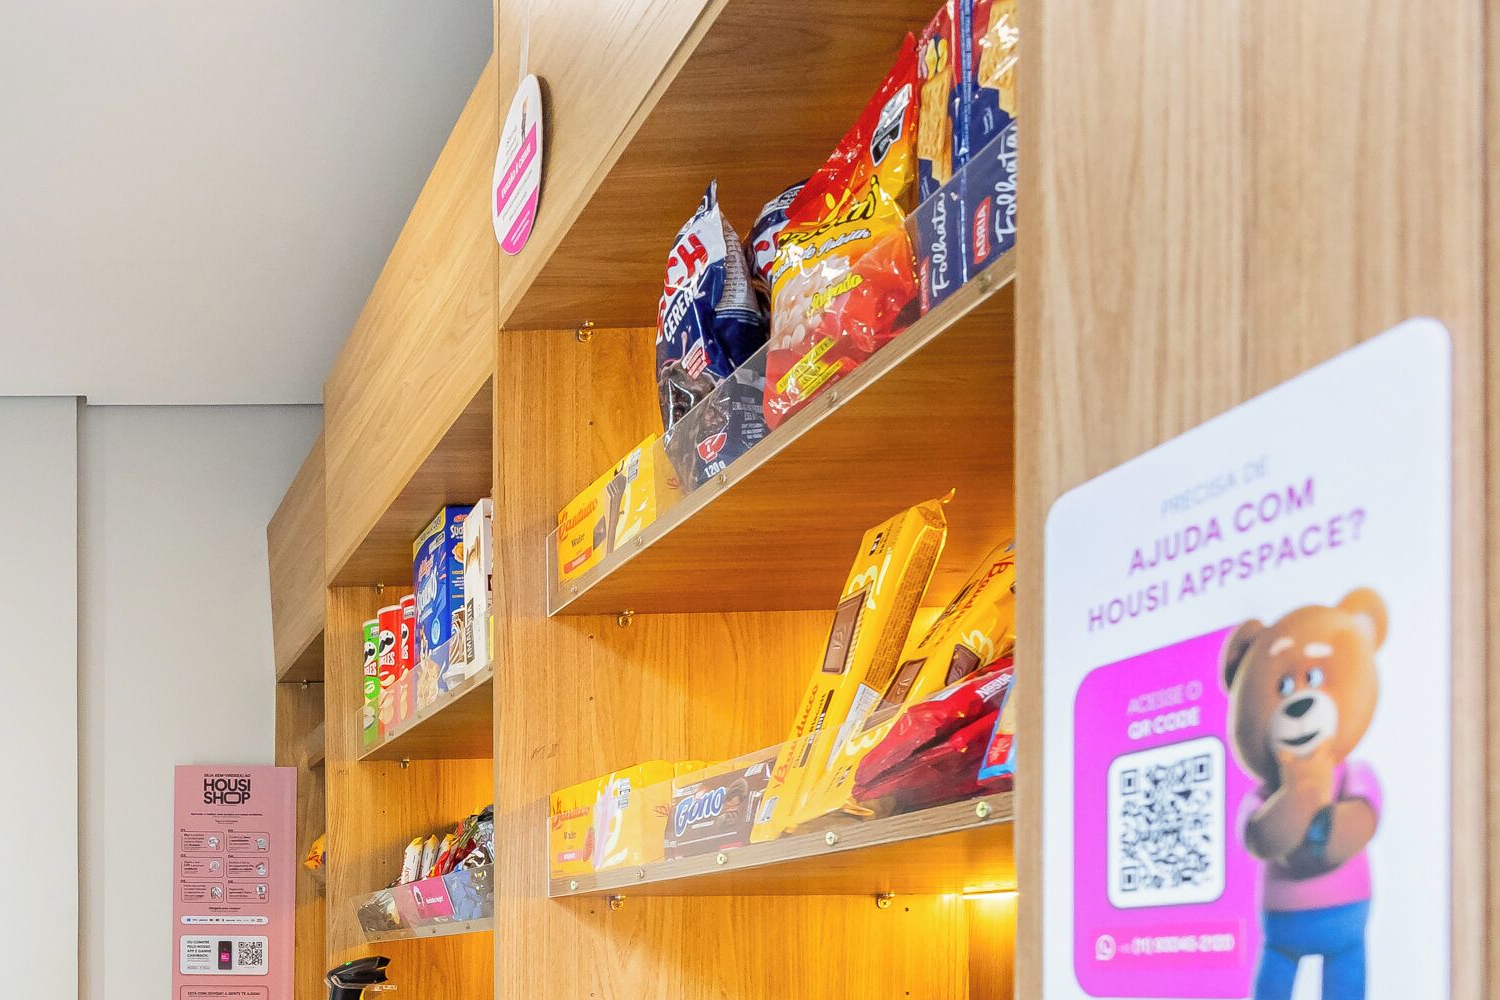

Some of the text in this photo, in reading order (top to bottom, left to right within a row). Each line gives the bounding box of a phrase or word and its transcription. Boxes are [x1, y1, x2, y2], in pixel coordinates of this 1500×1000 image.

[662, 284, 707, 344] CEREAL
[1160, 454, 1270, 516] PRECISA DE
[1127, 475, 1316, 577] AJUDA COM
[1086, 507, 1368, 635] HOUSI APPSPACE?
[1127, 679, 1204, 716] ACESSE O
[1127, 705, 1201, 741] QR CODE
[203, 778, 251, 792] HOUSI
[203, 791, 251, 805] SHOP
